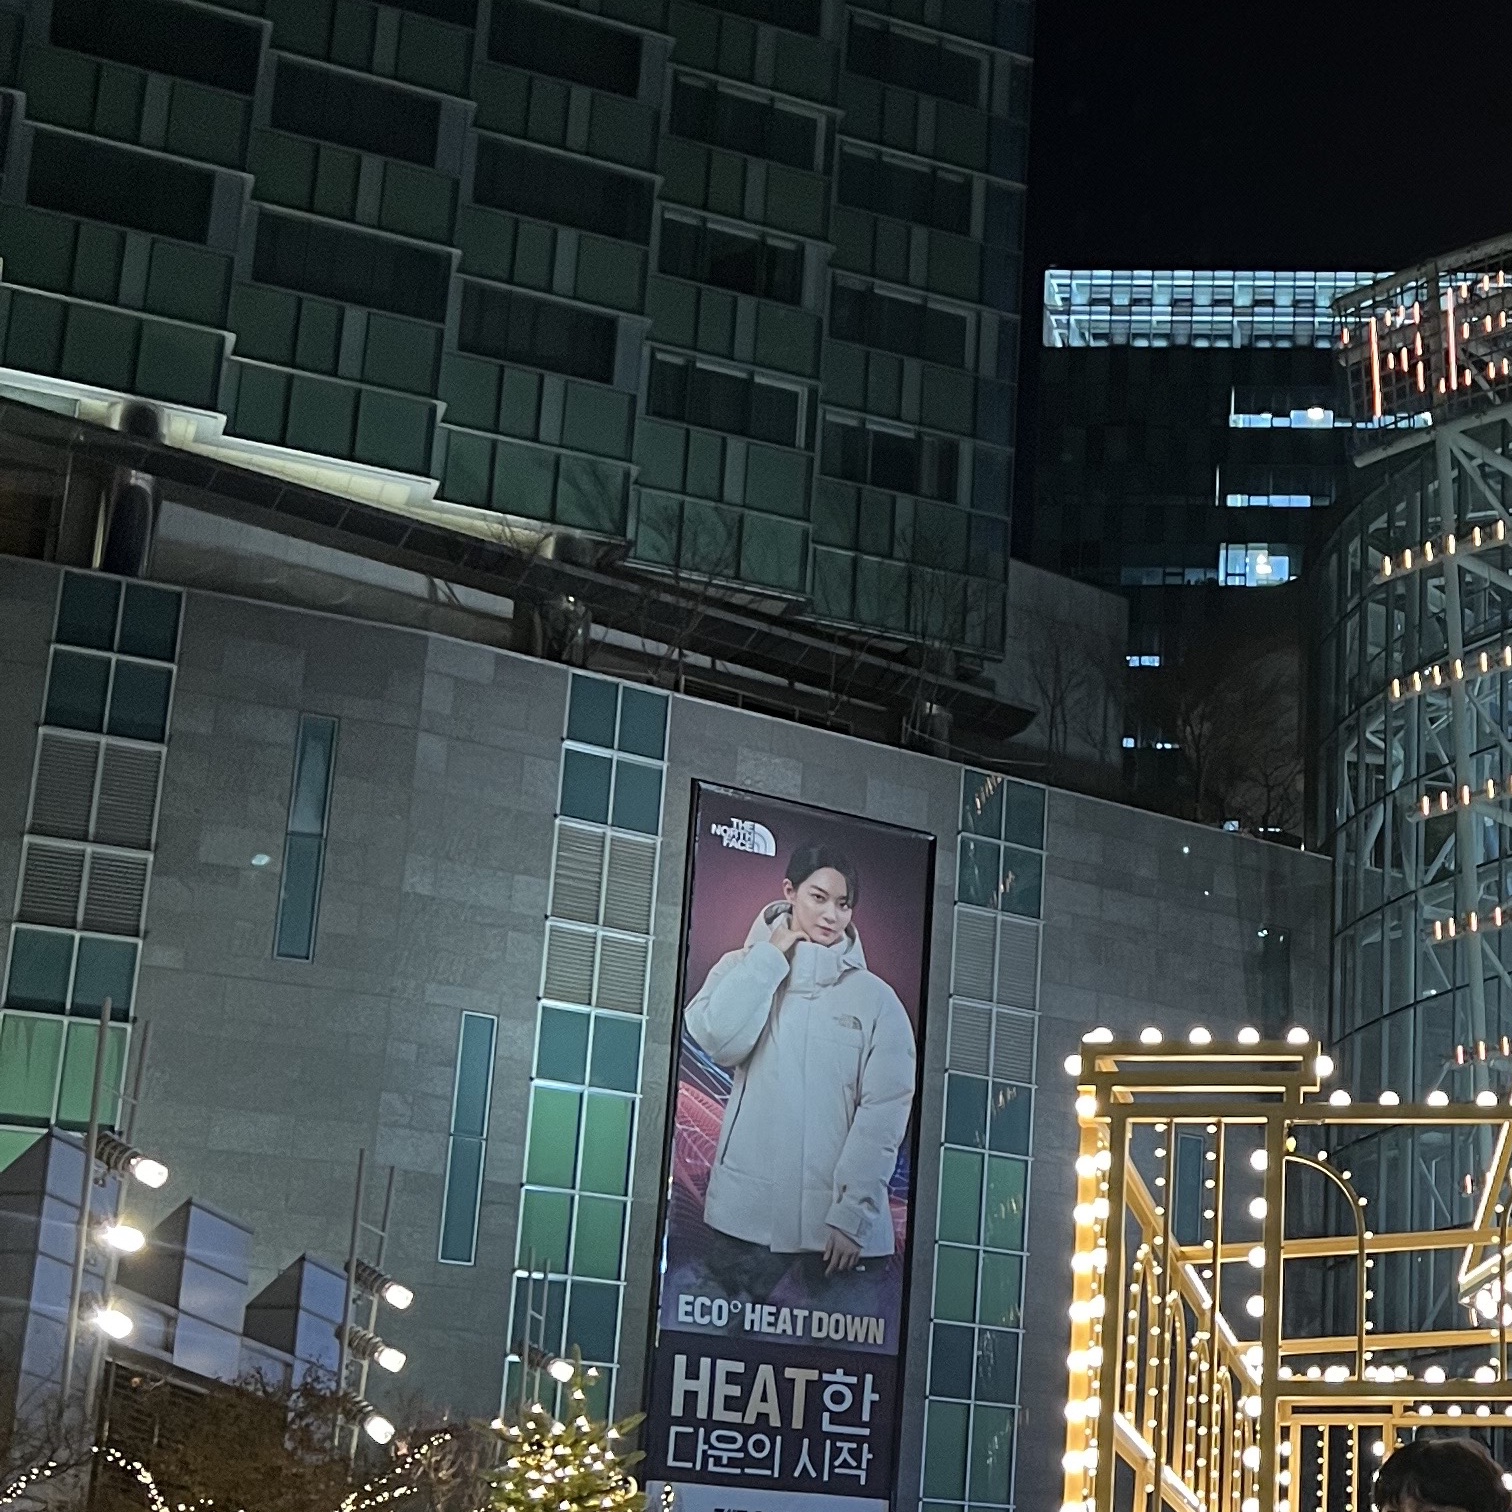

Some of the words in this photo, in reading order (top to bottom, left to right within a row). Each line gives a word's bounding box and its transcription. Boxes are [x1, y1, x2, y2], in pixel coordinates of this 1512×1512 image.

[711, 824, 754, 842] NORTH
[730, 818, 754, 831] THE
[722, 835, 754, 852] FACE
[743, 1303, 811, 1337] HEAT
[811, 1311, 885, 1345] DOWN
[666, 1425, 783, 1478] 다운의
[793, 1437, 874, 1486] 시작
